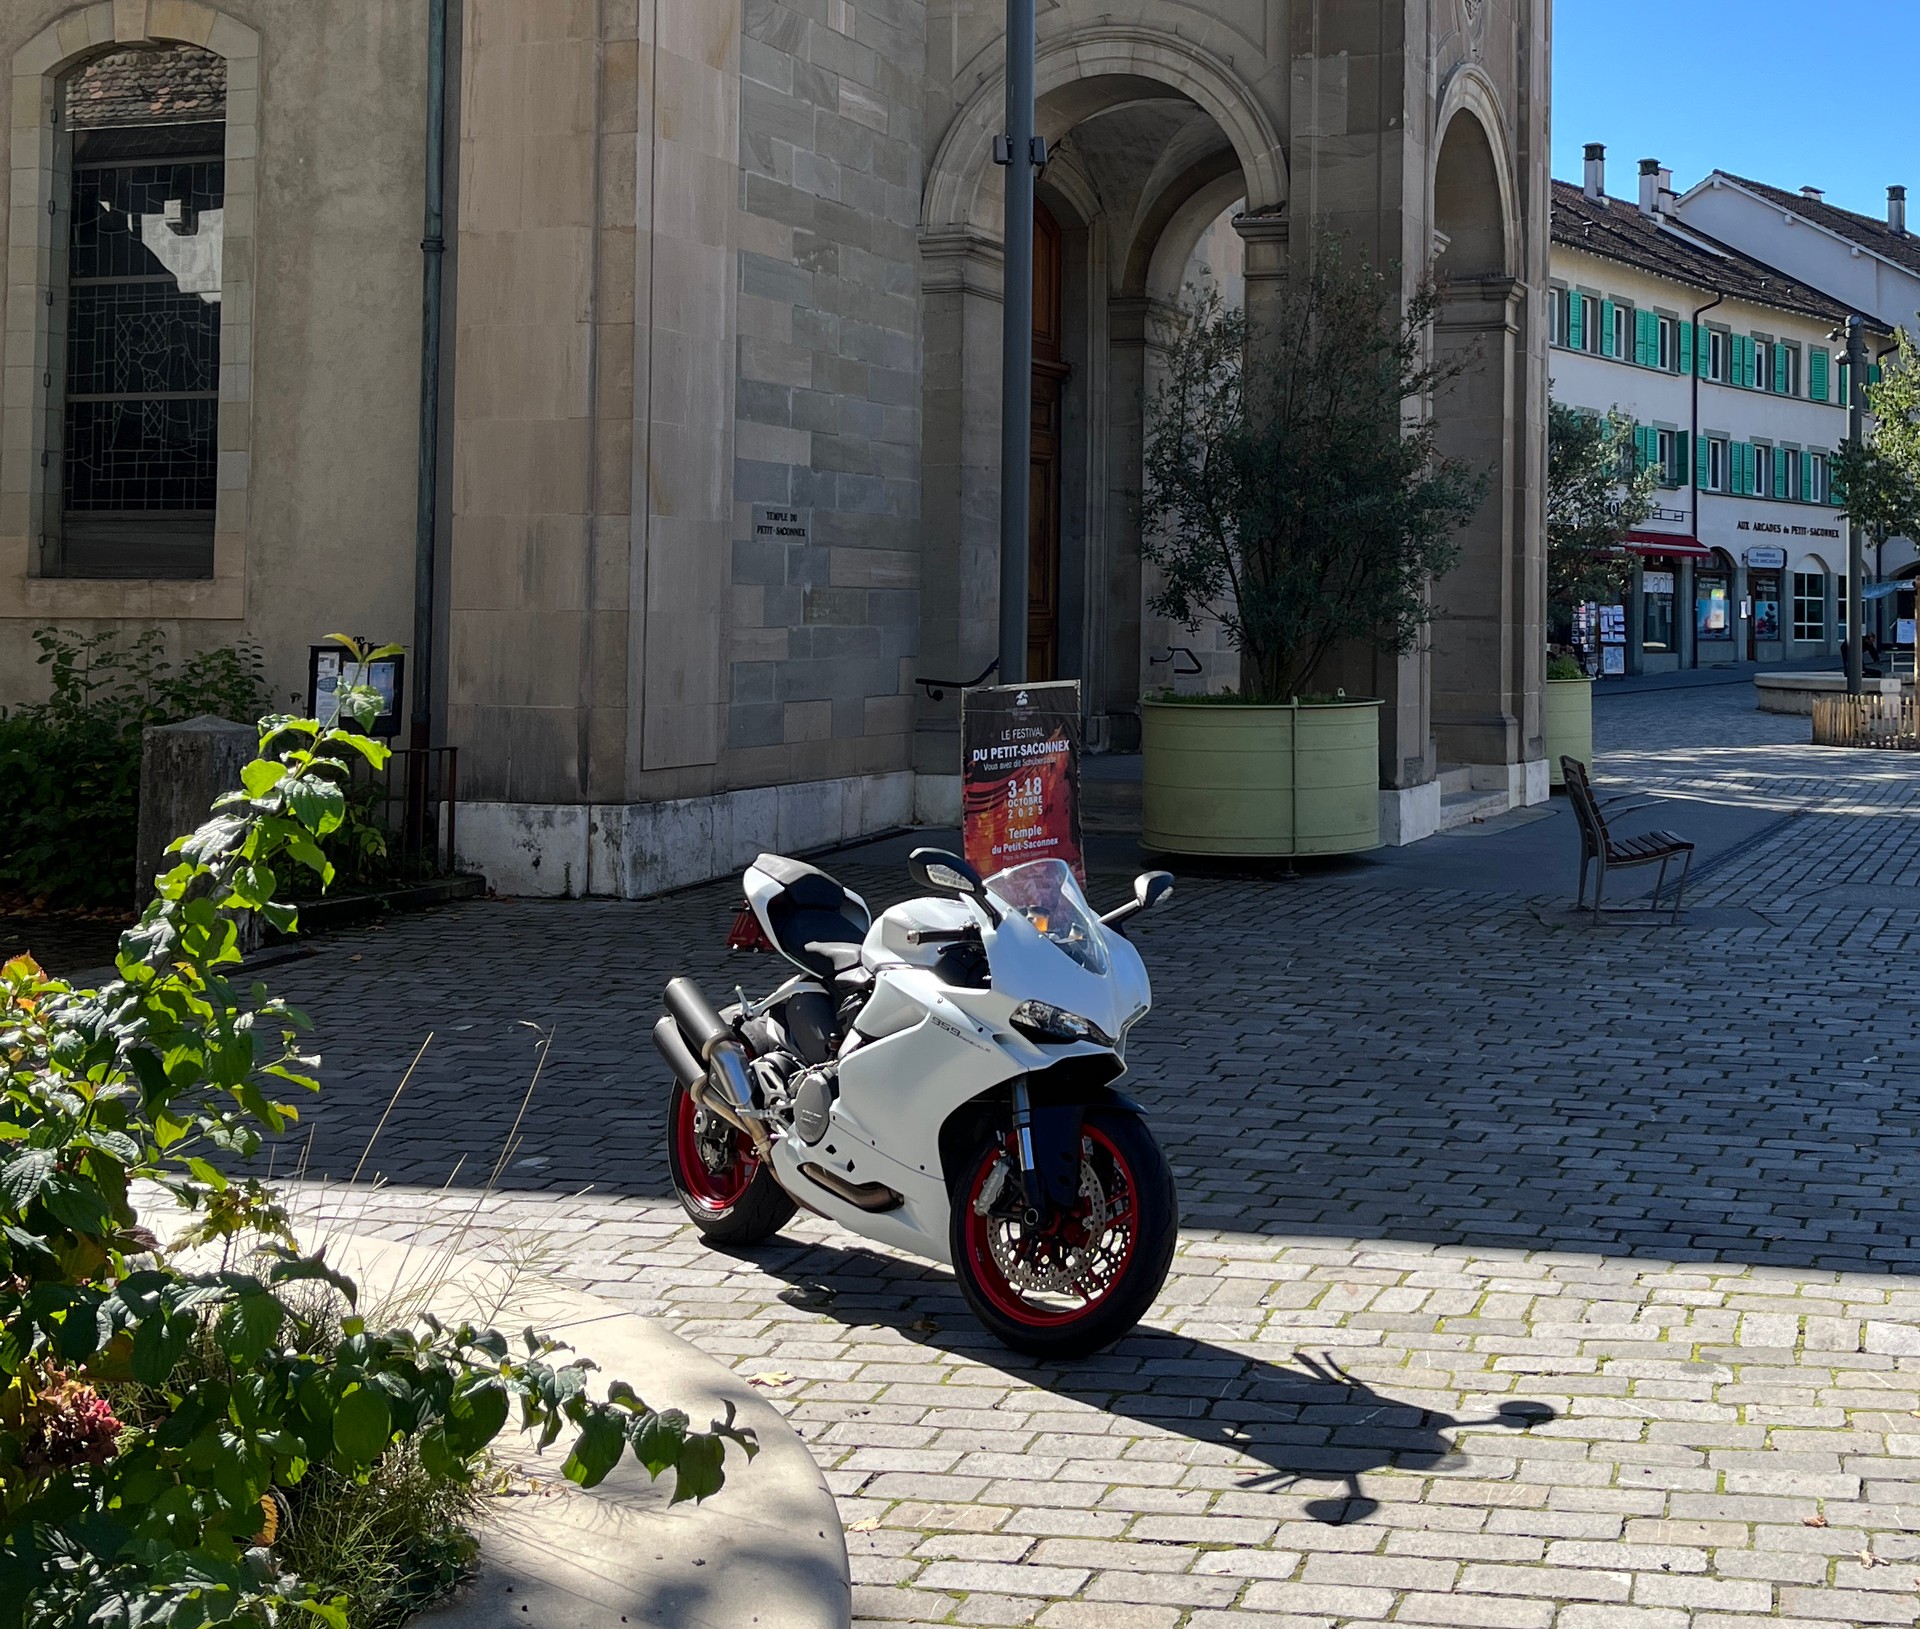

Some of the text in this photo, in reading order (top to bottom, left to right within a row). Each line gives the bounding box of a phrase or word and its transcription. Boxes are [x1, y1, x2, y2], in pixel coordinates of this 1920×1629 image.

[766, 511, 798, 522] TEMPLE DU
[1737, 520, 1749, 530] AUX
[1753, 522, 1781, 534] ARCADES
[1791, 525, 1839, 538] PETIT-SACONNEX
[1001, 727, 1044, 741] LE FESTIVAL
[973, 740, 1070, 761] DU PETIT-SACONNEX
[983, 763, 998, 771] Vous
[999, 761, 1012, 770] avez
[1008, 776, 1042, 799] 3-18
[1008, 795, 1043, 808] OCTOBRE
[1008, 824, 1042, 839] Temple
[991, 837, 1059, 855] du Petit-Saconnex
[931, 1016, 961, 1037] 959
